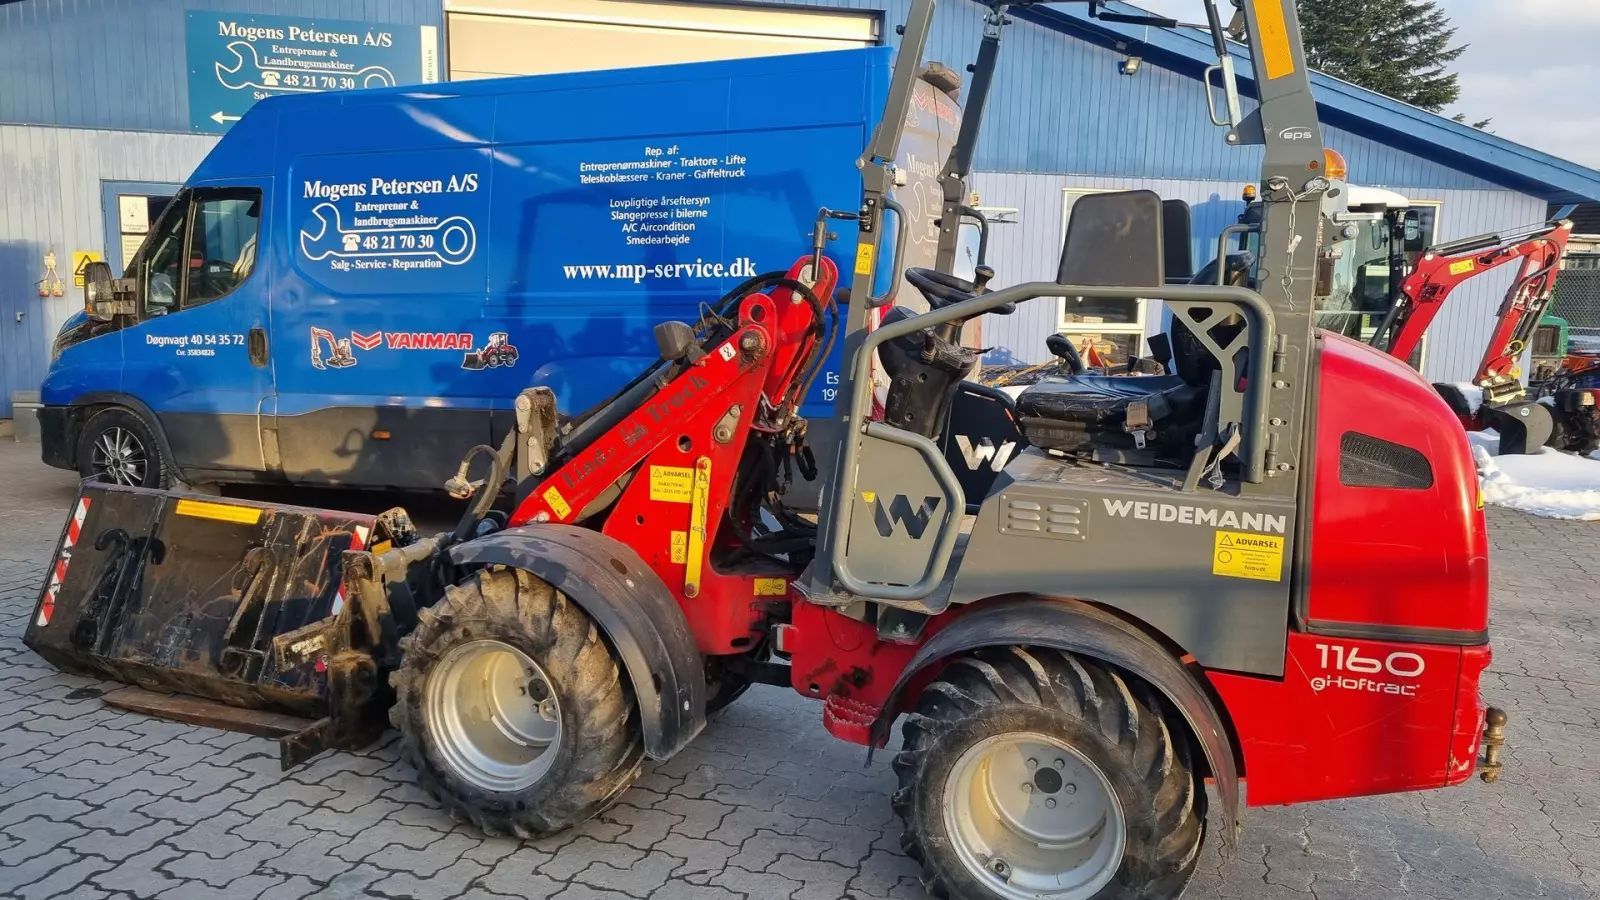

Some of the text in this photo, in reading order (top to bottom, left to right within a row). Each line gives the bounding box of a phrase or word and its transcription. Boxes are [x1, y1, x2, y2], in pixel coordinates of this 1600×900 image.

[218, 21, 393, 48] Mogens Petersen A/S
[272, 44, 338, 58] Entreprenør &
[264, 56, 355, 71] Landbrugsmaskiner
[284, 74, 355, 90] 48 21 70 30
[253, 91, 271, 100] Sal
[1284, 132, 1312, 140] eps
[645, 145, 680, 157] Rep. af:
[580, 159, 672, 174] Entreprenørmaskiner
[680, 157, 718, 168] Traktore
[725, 156, 746, 166] Lifte
[580, 174, 648, 184] Teleskoblæssere
[656, 172, 686, 180] Kraner
[694, 168, 746, 180] Gaffeltruck
[303, 173, 478, 201] Mogens Petersen A/S
[355, 200, 419, 212] Entreprenør &
[610, 196, 710, 209] Lovpligtige årseftersyn
[611, 208, 708, 222] Slangepresse i bilerne
[622, 221, 696, 233] A/C Aircondition
[362, 234, 434, 250] 48 21 70 30
[626, 234, 690, 246] Smedearbejde
[331, 260, 350, 272] Salg
[355, 259, 387, 270] Service
[392, 258, 442, 270] Reparation
[563, 257, 758, 284] www.mp-service.dk
[146, 334, 244, 348] Døgnvagt 40 54 35 72
[384, 332, 472, 350] YANMAR
[822, 388, 838, 401] 19
[1102, 498, 1286, 534] WEIDEMANN
[1236, 538, 1278, 549] ADVARSEL
[1316, 644, 1425, 677] 1160
